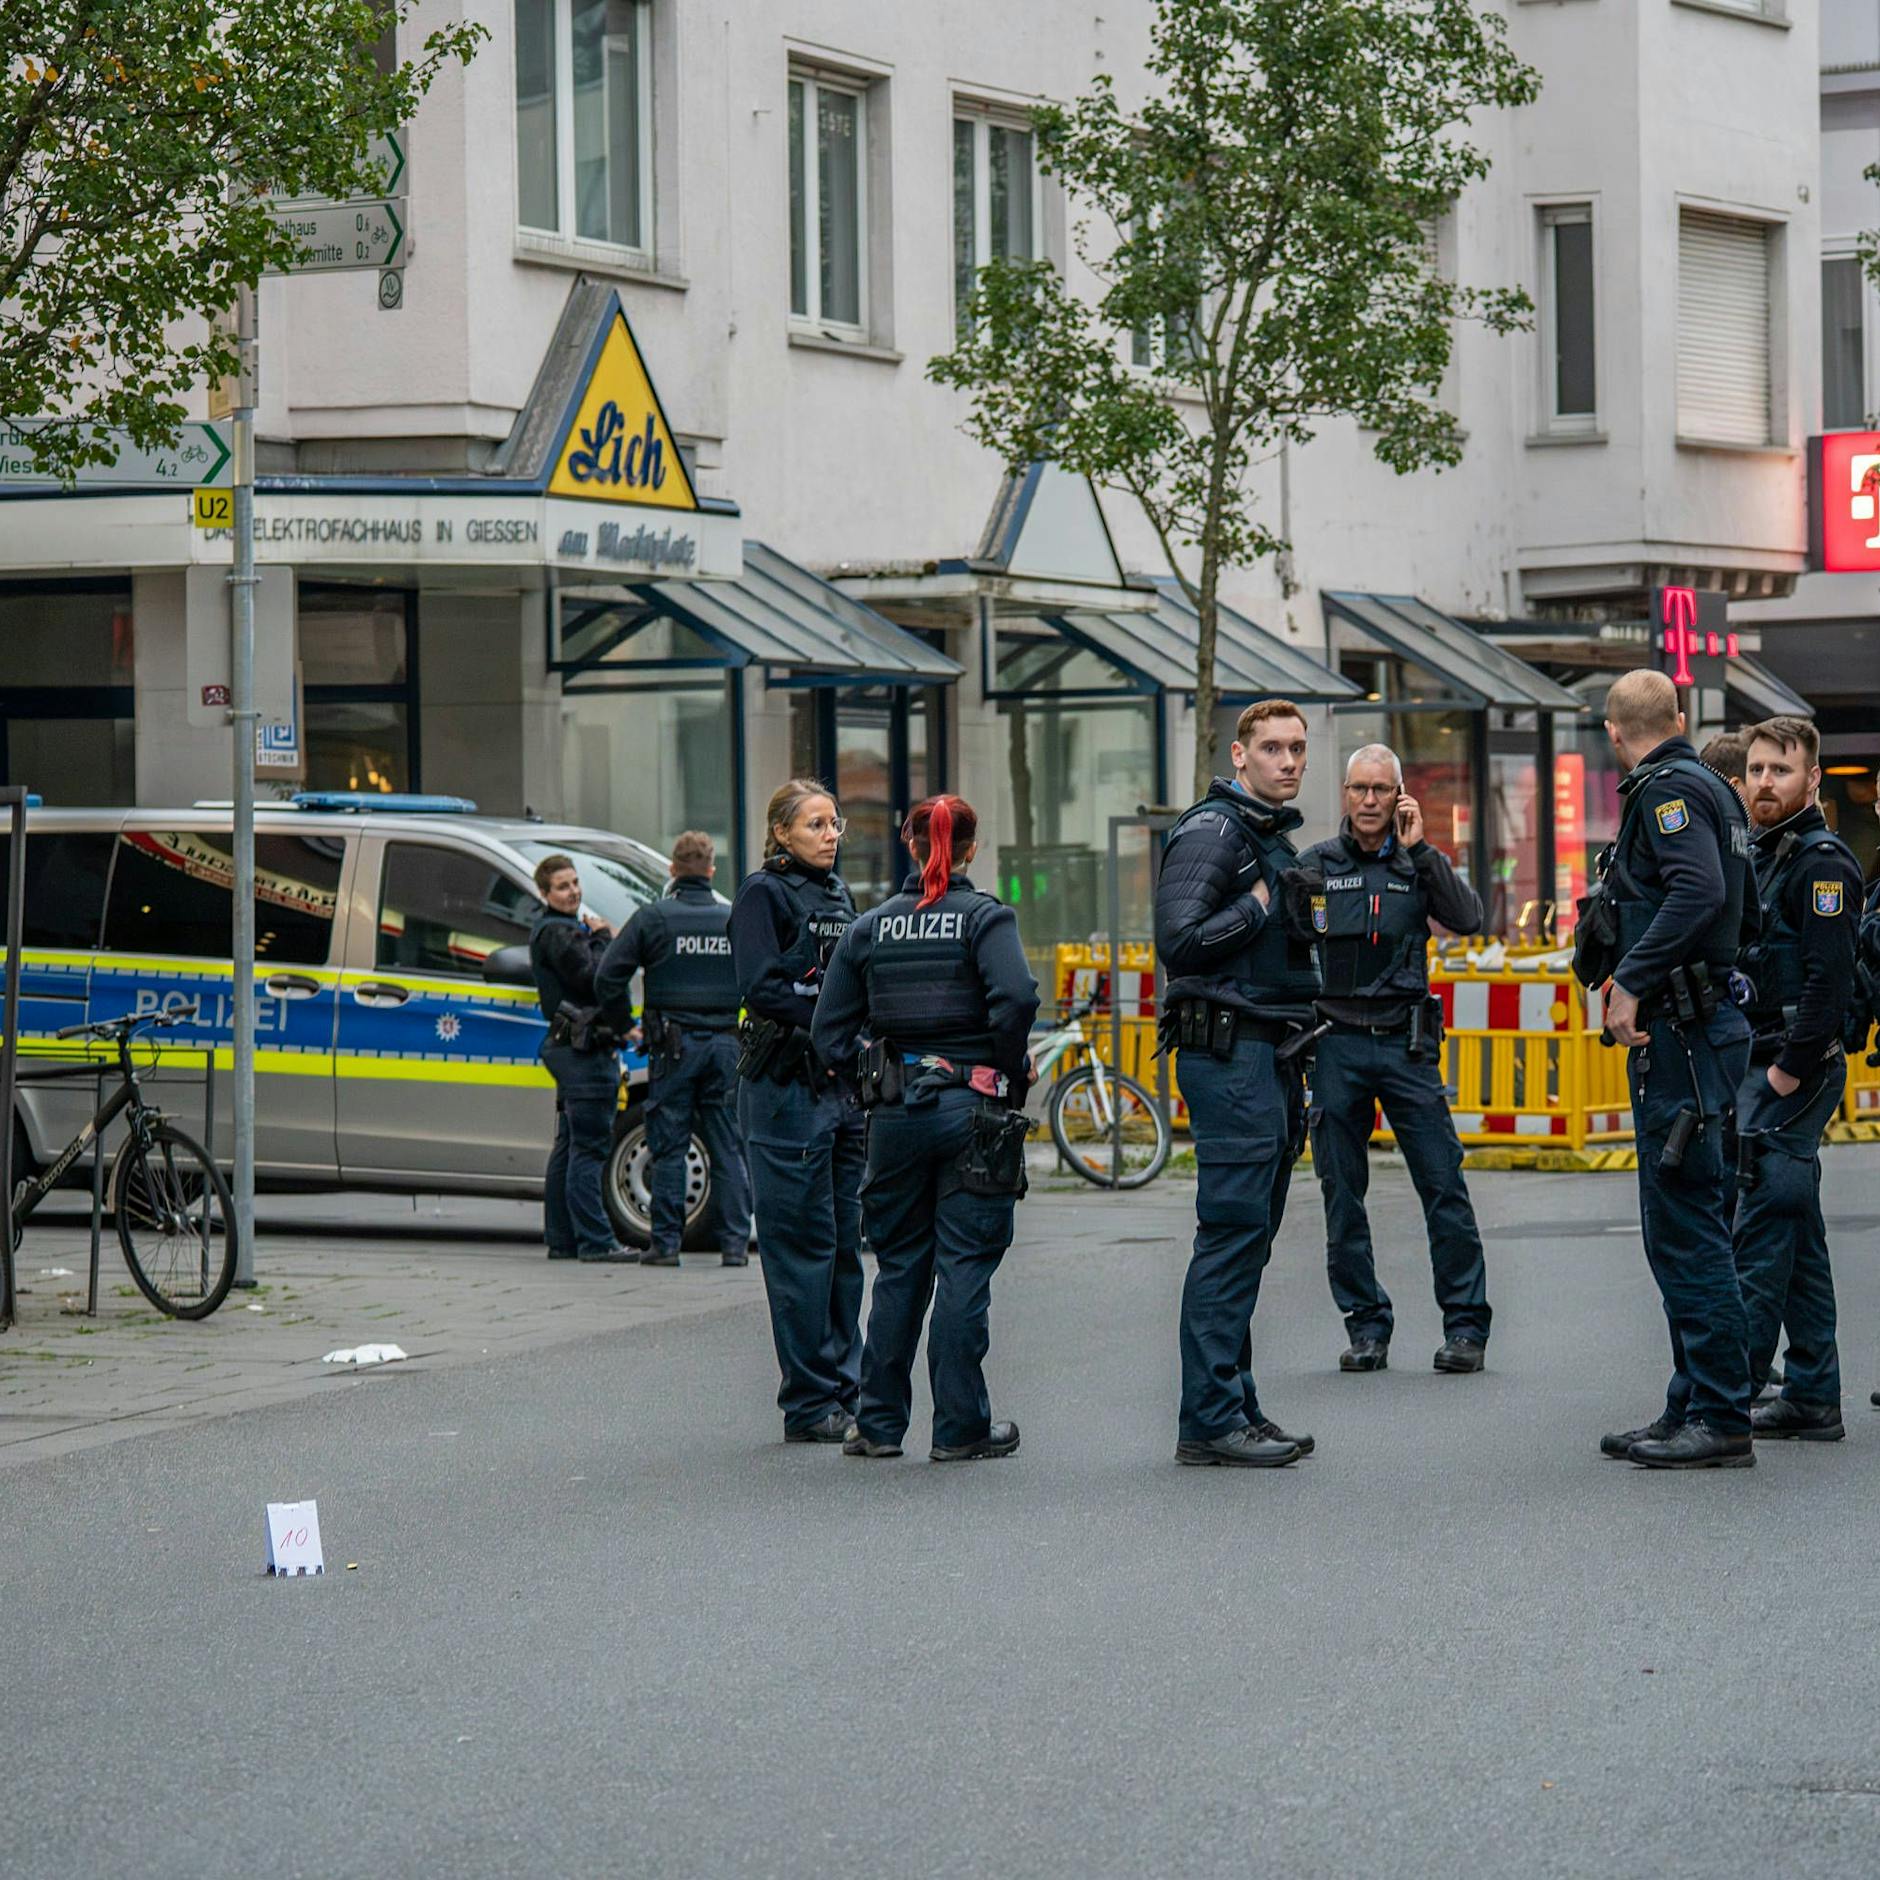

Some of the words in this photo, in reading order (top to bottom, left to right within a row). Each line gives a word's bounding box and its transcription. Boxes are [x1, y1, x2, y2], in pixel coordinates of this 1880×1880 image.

[270, 219, 317, 239] athaus
[569, 400, 667, 491] Lich
[198, 496, 229, 519] U2
[204, 527, 234, 541] DA
[252, 518, 422, 543] ELEKTROFACHHAUS
[436, 519, 453, 541] IN
[466, 518, 538, 543] GIESSEN
[1326, 877, 1362, 891] POLIZEI
[820, 921, 848, 937] POLIZE
[878, 913, 964, 943] POLIZEI
[676, 936, 732, 955] POLIZEI
[280, 1526, 308, 1550] 10
